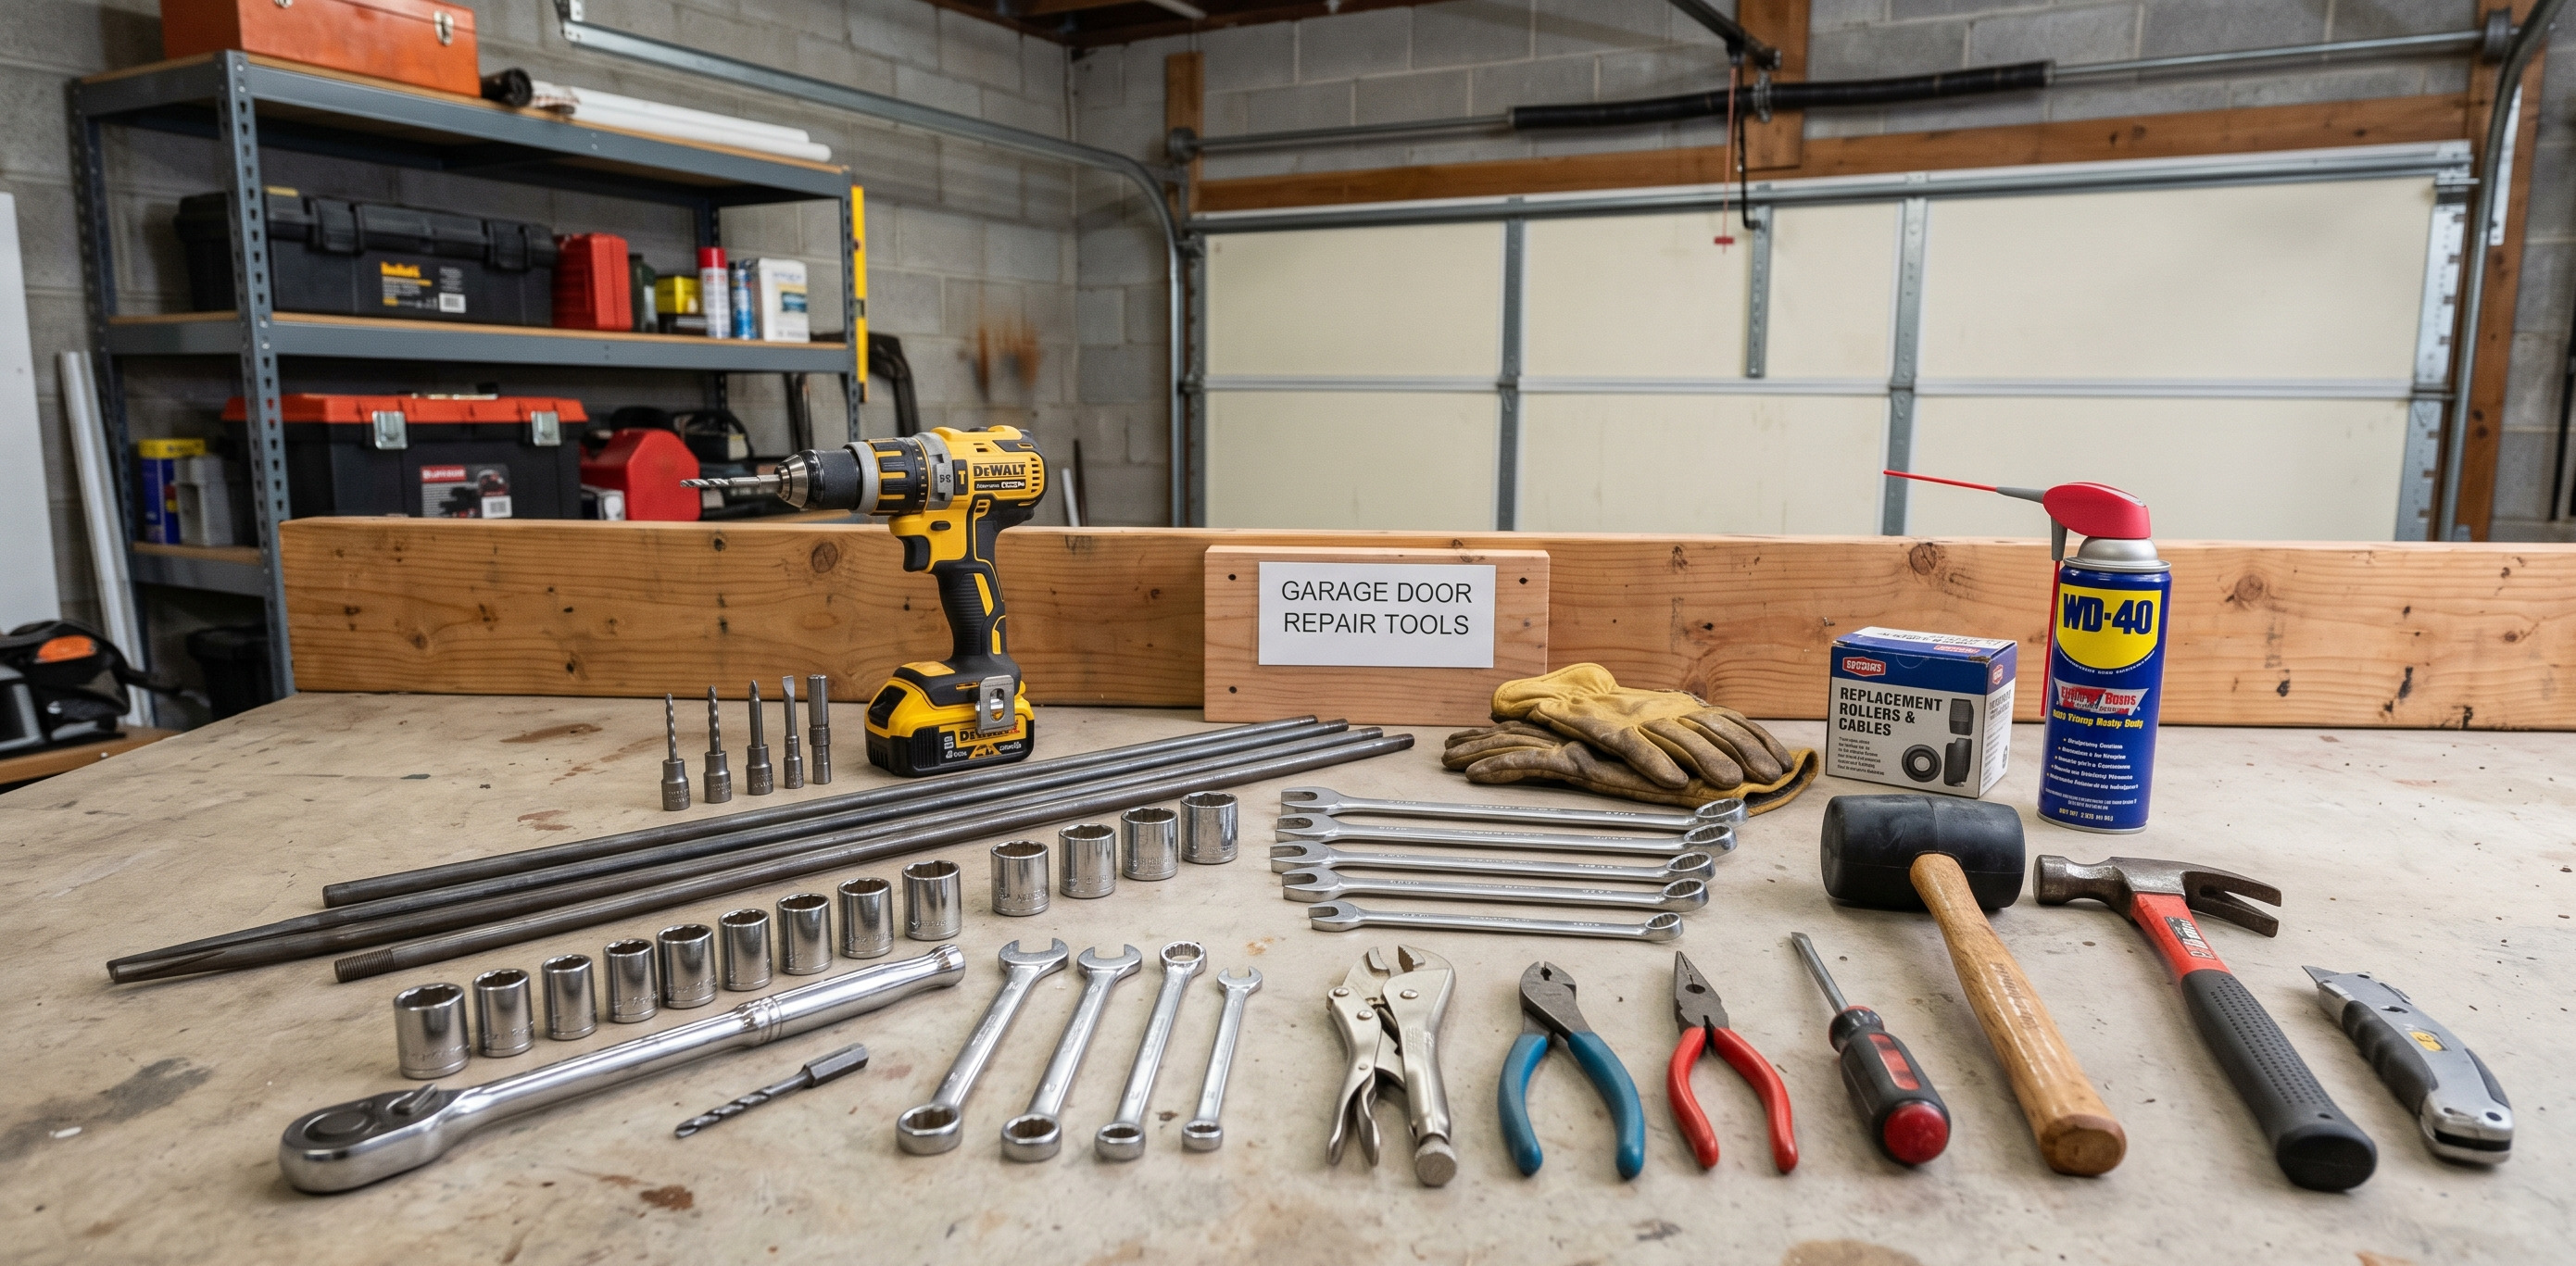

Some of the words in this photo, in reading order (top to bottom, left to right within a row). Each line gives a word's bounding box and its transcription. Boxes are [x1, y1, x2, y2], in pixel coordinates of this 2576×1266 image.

[973, 464, 1025, 477] DEWALT
[1281, 581, 1388, 602] GARAGE
[1397, 583, 1473, 603] DOOR
[1284, 612, 1376, 633] REPAIR
[1385, 614, 1469, 635] TOOLS
[2063, 593, 2154, 634] WD-40
[1840, 687, 1942, 711] REPLACEMENT
[1839, 702, 1901, 721] ROLLERS
[1904, 711, 1916, 723] &
[1839, 718, 1891, 736] CABLES
